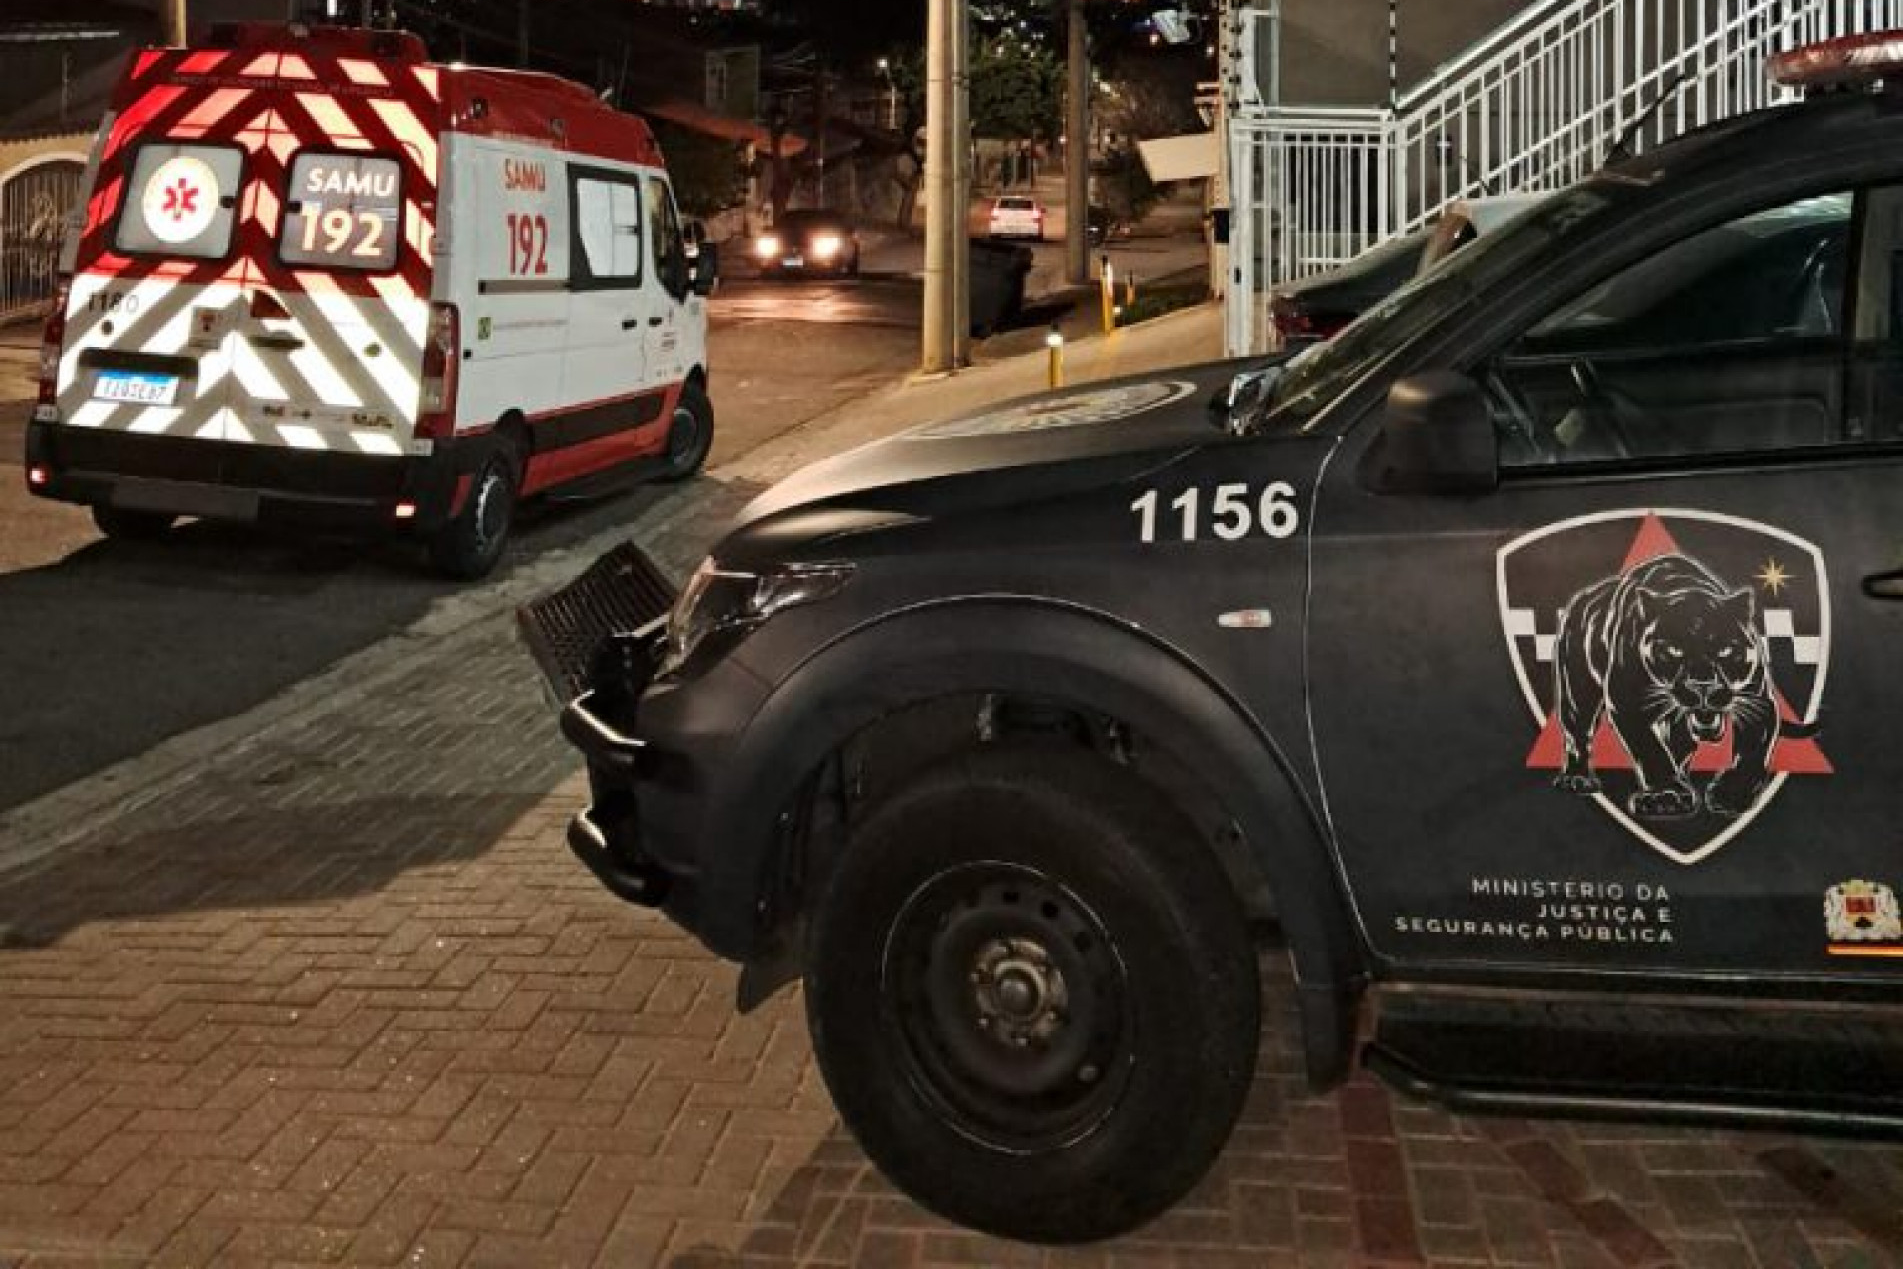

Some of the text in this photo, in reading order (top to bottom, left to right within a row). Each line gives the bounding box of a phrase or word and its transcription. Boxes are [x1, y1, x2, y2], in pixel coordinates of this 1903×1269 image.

[307, 167, 396, 197] SAMU
[505, 158, 546, 192] SAMU
[302, 200, 383, 256] 192
[507, 213, 548, 276] 192
[1130, 481, 1299, 543] 1156
[1637, 884, 1670, 901] DA
[1395, 916, 1549, 939] SEGURANÇA
[1538, 904, 1673, 924] JUSTIÇA E
